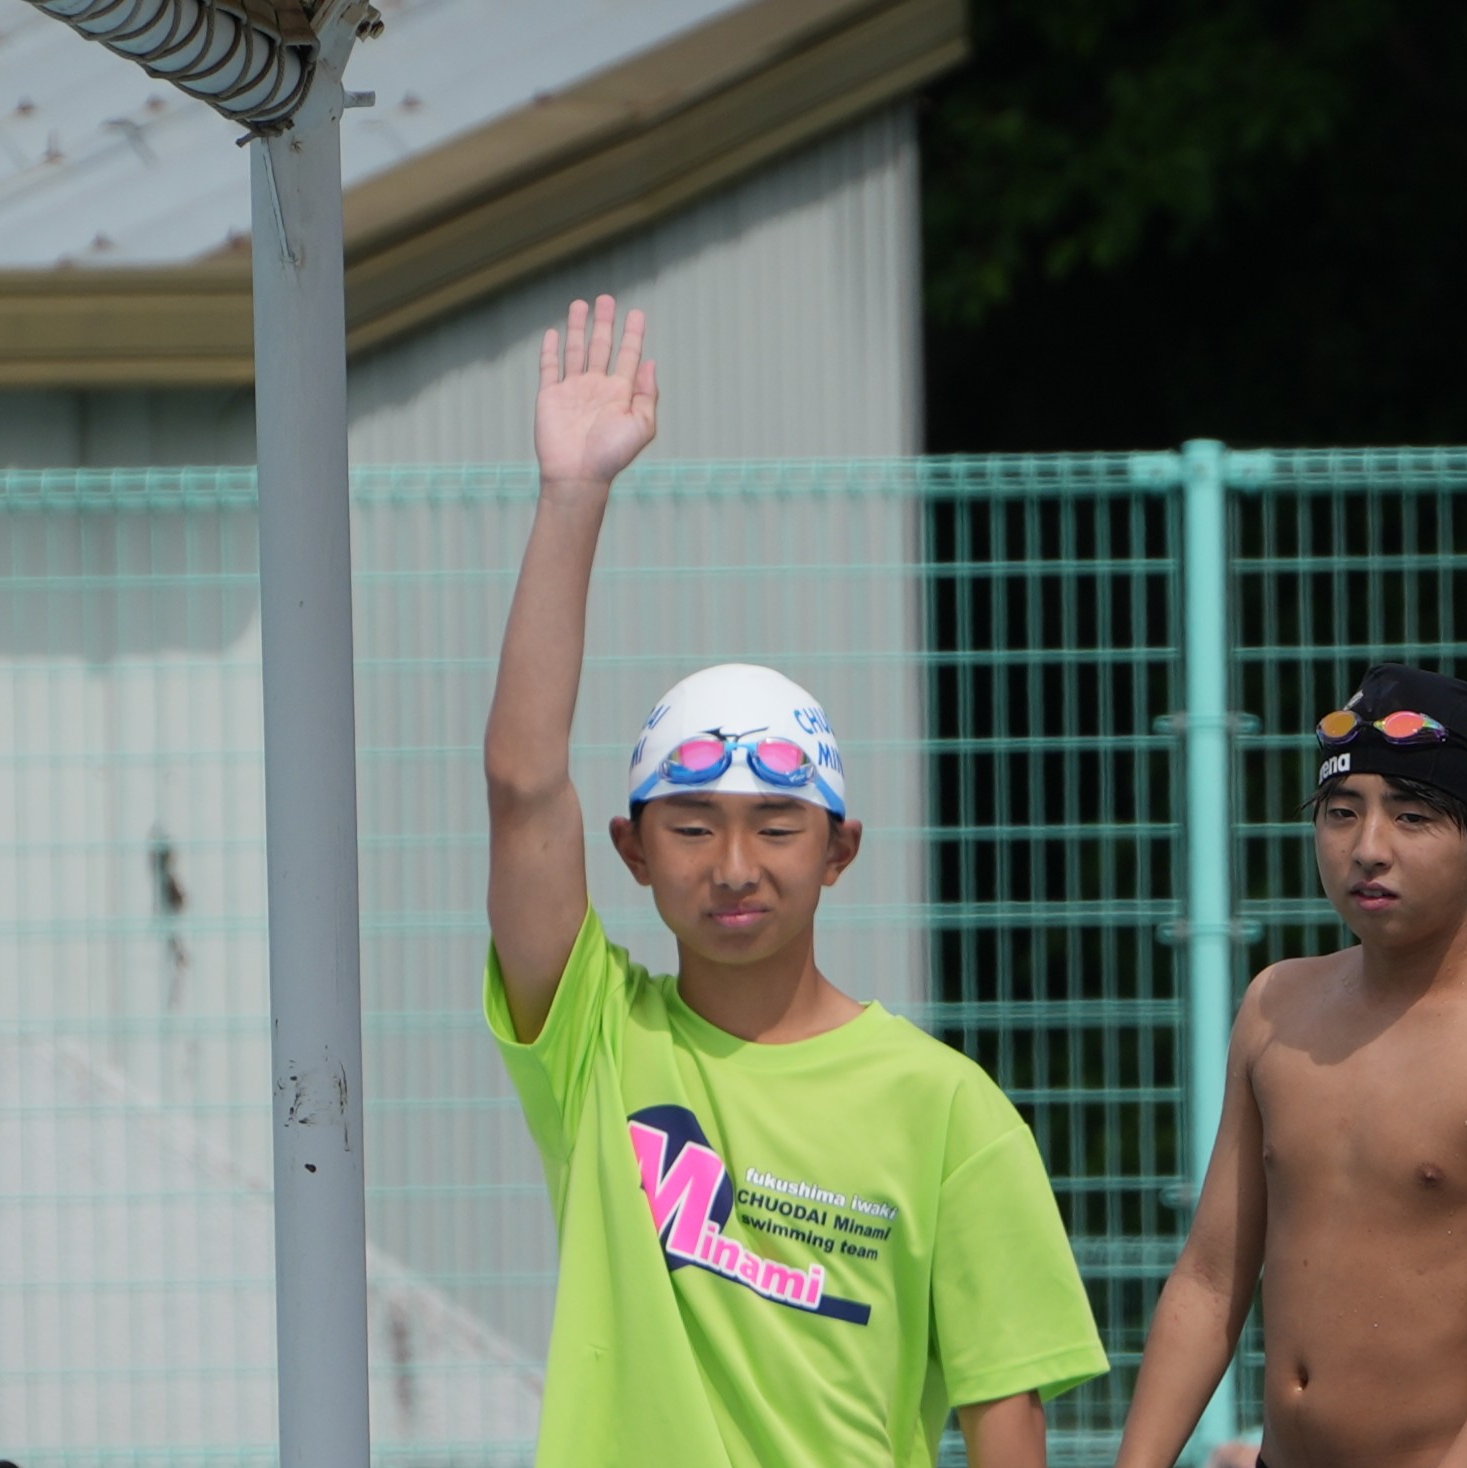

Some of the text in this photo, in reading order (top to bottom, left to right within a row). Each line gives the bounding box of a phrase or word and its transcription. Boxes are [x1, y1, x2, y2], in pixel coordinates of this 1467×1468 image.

[1318, 753, 1350, 785] rena
[628, 1120, 825, 1310] Minami
[737, 1189, 892, 1241] CHUODAI Minami
[745, 1167, 899, 1220] fukushima iwaki
[741, 1214, 878, 1260] swimming team
